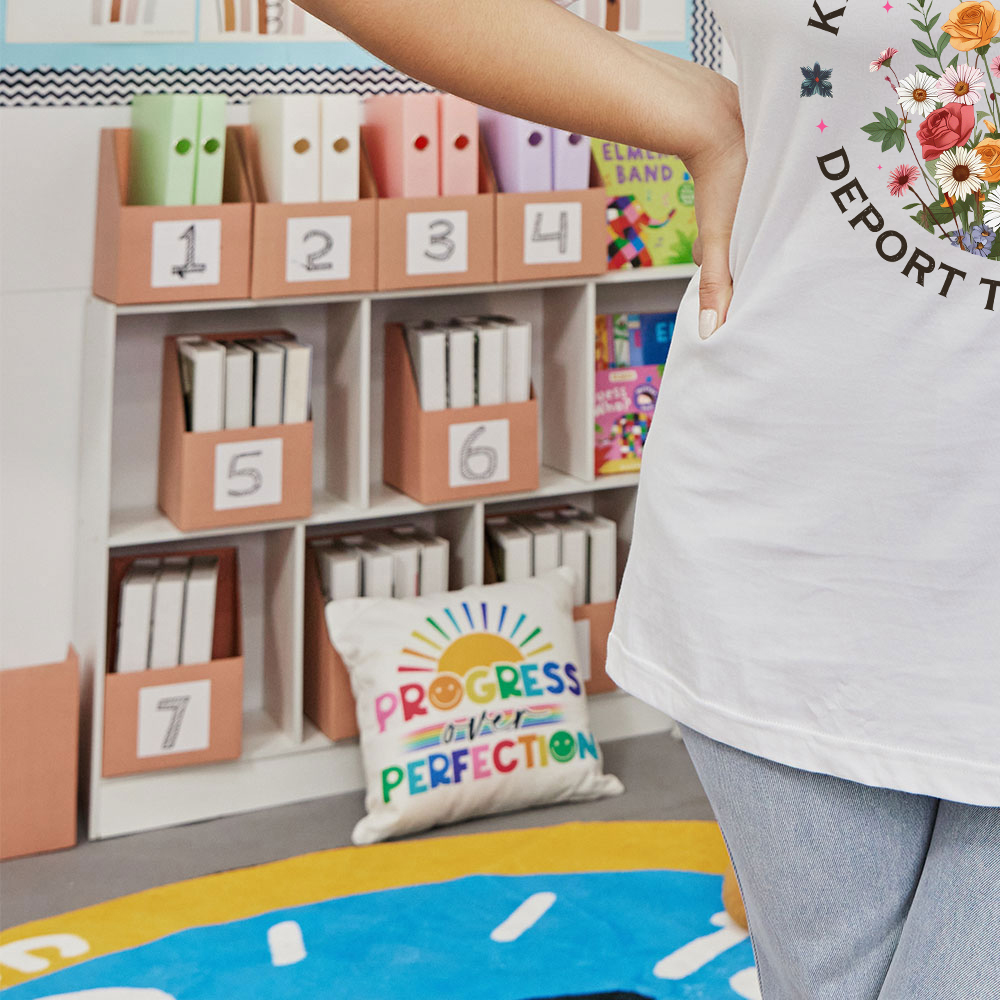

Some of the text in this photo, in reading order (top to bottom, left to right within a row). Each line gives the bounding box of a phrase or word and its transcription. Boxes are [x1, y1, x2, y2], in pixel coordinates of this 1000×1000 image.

[615, 164, 674, 185] BAND
[424, 219, 457, 261] 3
[531, 211, 568, 255] 4
[816, 145, 968, 302] DEPORT
[172, 223, 207, 279] 1
[302, 229, 334, 272] 2
[227, 450, 263, 498] 5
[460, 425, 499, 481] 6
[156, 695, 190, 751] 7
[375, 661, 581, 733] PROGRESS
[442, 707, 530, 744] over
[381, 730, 598, 804] PERFECTION
